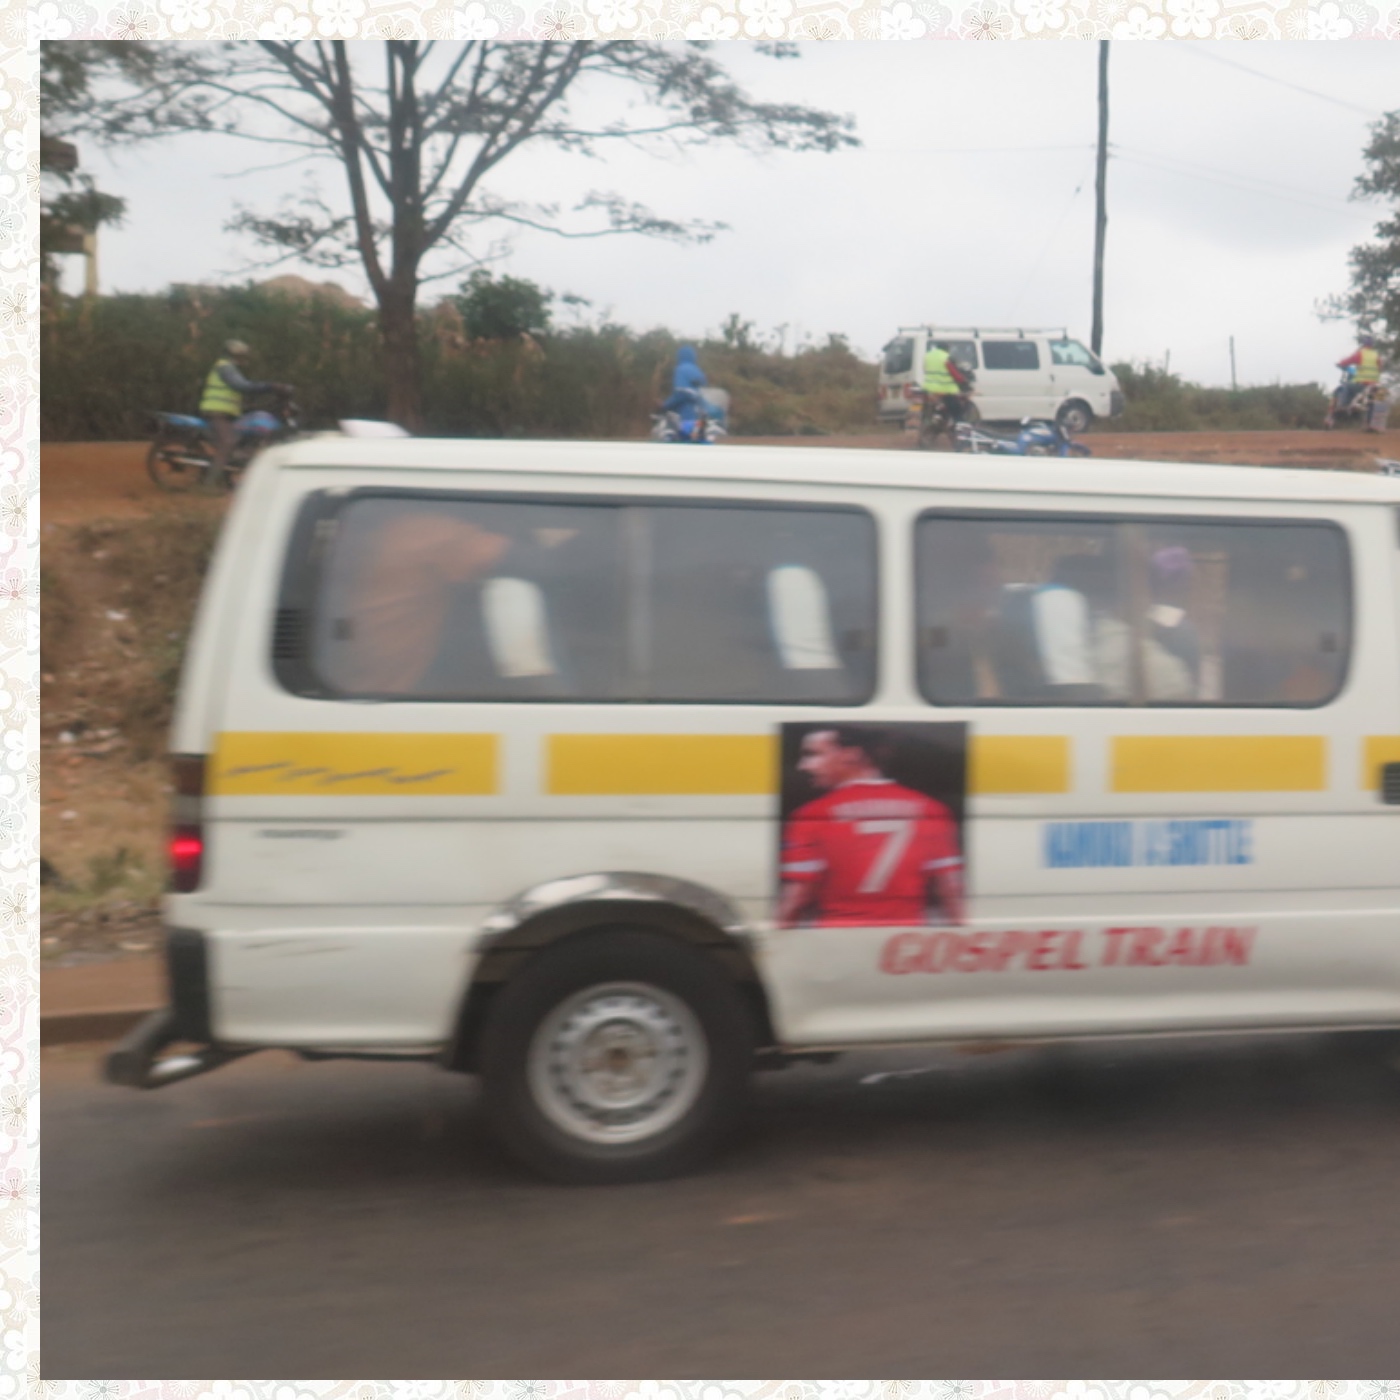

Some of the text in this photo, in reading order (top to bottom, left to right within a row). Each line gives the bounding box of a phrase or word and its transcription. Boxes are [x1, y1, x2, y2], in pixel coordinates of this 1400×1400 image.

[853, 819, 917, 894] 7
[881, 926, 1256, 975] GOSPEL TRAIN
